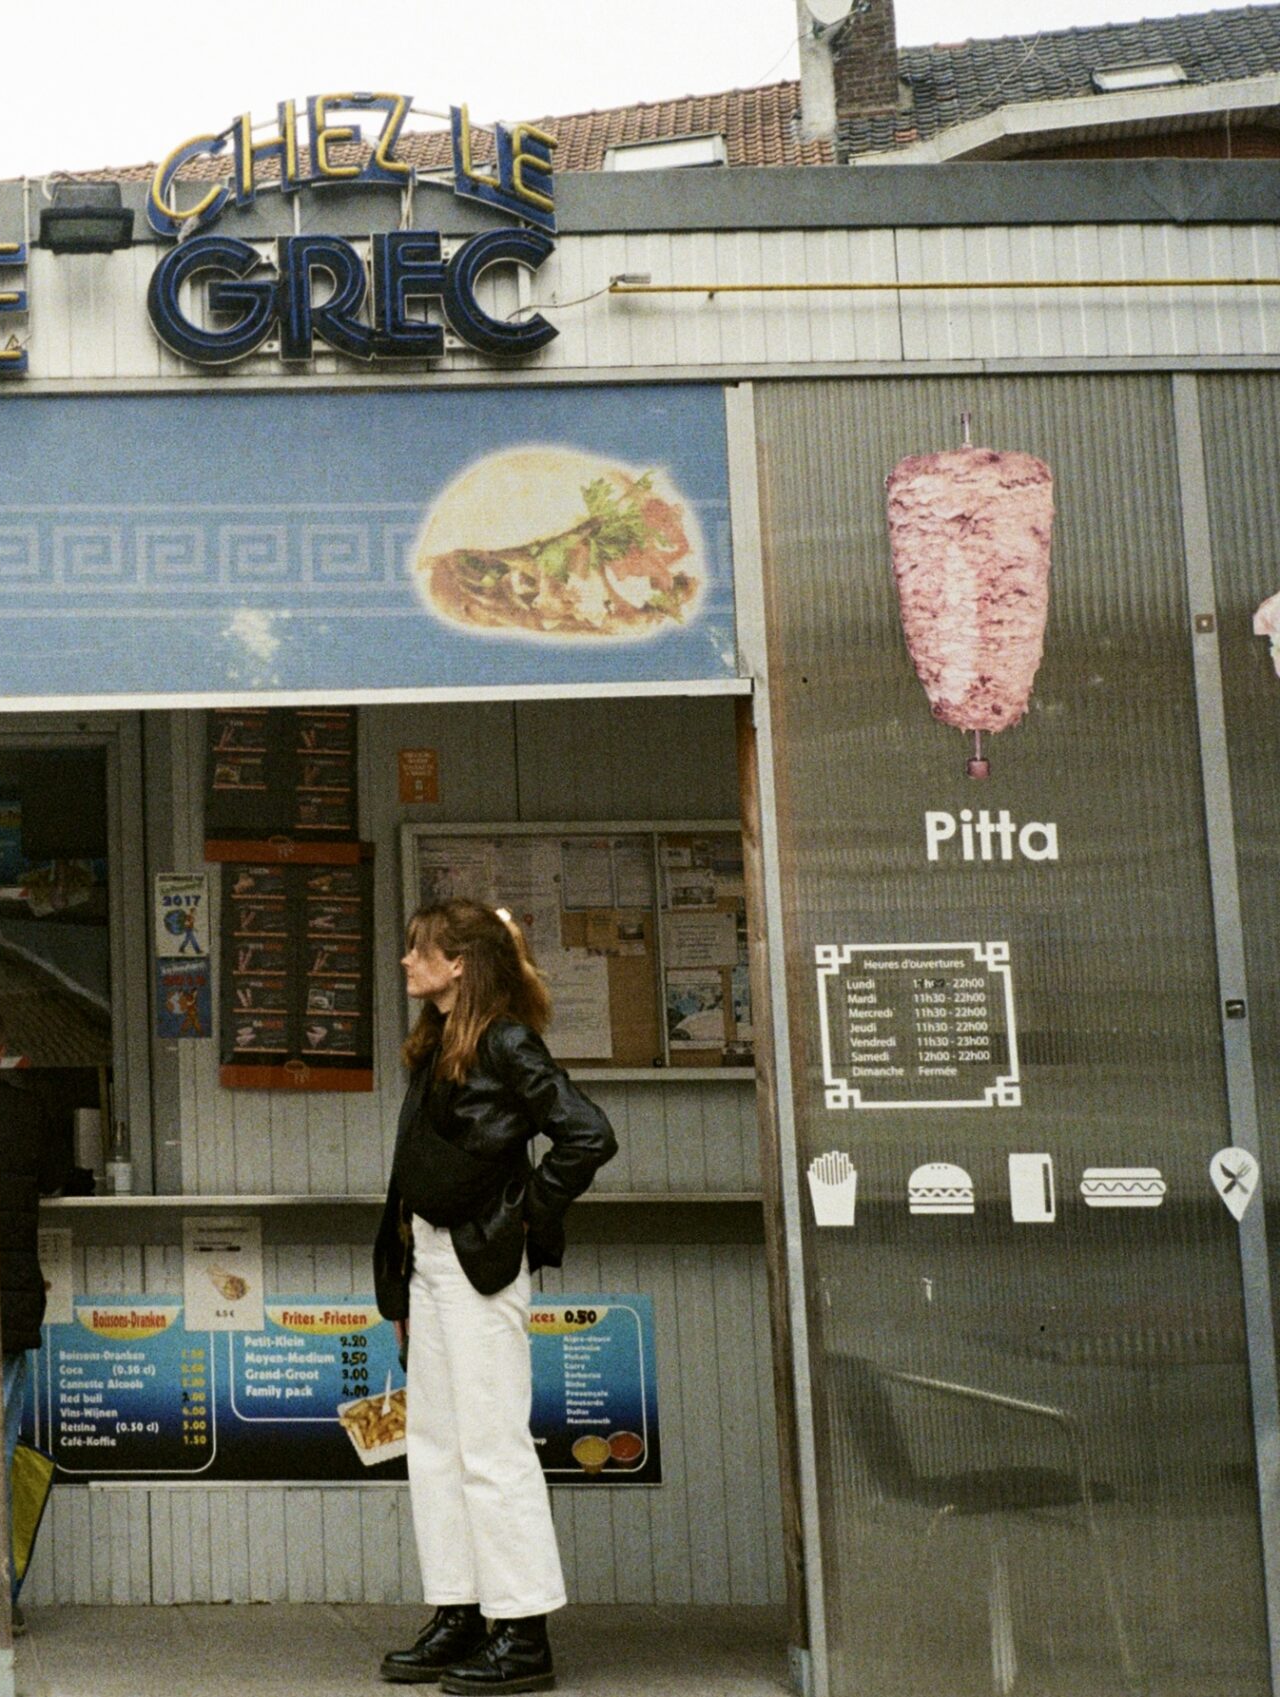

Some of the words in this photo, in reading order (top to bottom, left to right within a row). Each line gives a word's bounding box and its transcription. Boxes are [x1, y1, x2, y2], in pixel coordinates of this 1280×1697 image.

[146, 91, 415, 236] CHEZ
[450, 101, 559, 233] LE
[146, 228, 560, 364] GREC
[925, 809, 1059, 861] Pitta
[163, 895, 201, 907] 2017
[863, 959, 899, 970] Heures
[901, 957, 965, 969] d'ouvertures
[846, 979, 876, 990] Lundi
[953, 978, 984, 987] 22h00
[848, 994, 878, 1003] Mardi
[913, 992, 946, 1002] 11h30
[954, 992, 986, 1002] 22h00
[848, 1007, 894, 1018] Mercredi
[915, 1007, 946, 1017] 11h30
[954, 1007, 986, 1017] 22h00
[850, 1022, 878, 1033] Jeudi
[916, 1022, 948, 1032] 11h30
[956, 1022, 988, 1032] 22h00
[850, 1036, 897, 1047] Vendredi
[917, 1036, 948, 1046] 11h30
[956, 1036, 990, 1046] 23h00
[851, 1051, 890, 1062] Samedi
[918, 1051, 950, 1060] 12h00
[958, 1051, 990, 1060] 22h00
[852, 1066, 905, 1076] Dimanche
[92, 1311, 166, 1328] Boissons-Dranken
[282, 1311, 316, 1326] Frites
[564, 1309, 598, 1326] 0.50
[244, 1336, 306, 1348] Petit-Klein
[244, 1352, 336, 1366] Moyen-Medium
[59, 1364, 84, 1375] Coca
[244, 1368, 320, 1381] Grand-Groot
[60, 1378, 104, 1389] Cannette
[246, 1385, 281, 1398] Family
[285, 1385, 314, 1398] pack
[60, 1393, 80, 1404] Red
[83, 1393, 102, 1404] bull
[60, 1408, 118, 1420] Vins-Wijnen
[116, 1422, 144, 1434] (0.50
[146, 1422, 159, 1434] cl)
